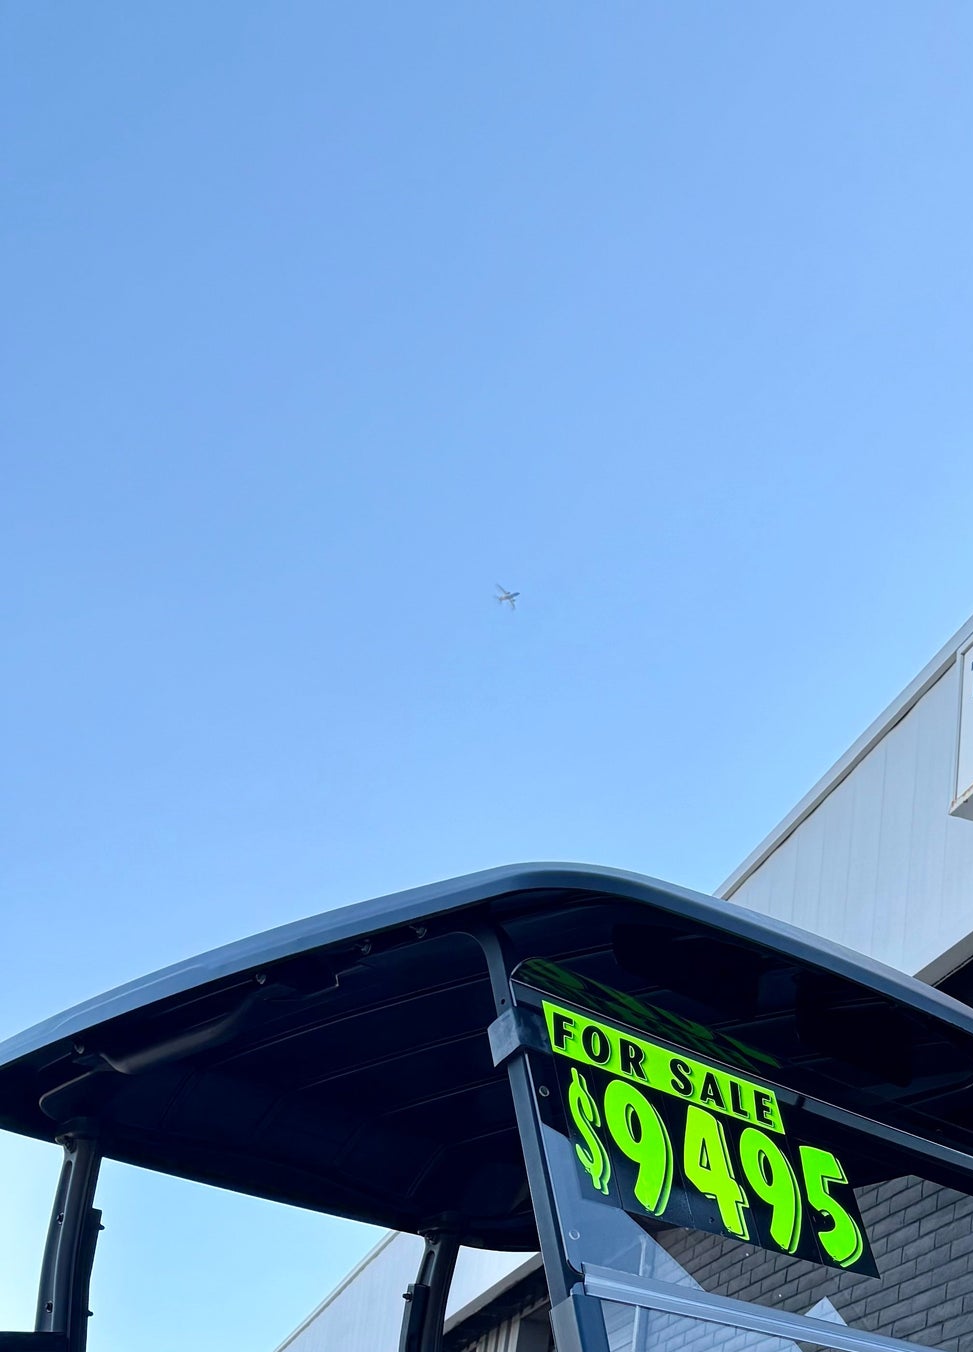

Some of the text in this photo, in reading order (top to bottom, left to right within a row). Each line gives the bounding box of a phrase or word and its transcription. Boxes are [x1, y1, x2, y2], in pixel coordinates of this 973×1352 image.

[552, 1011, 776, 1129] FOR SALE
[568, 1067, 863, 1268] $9495
